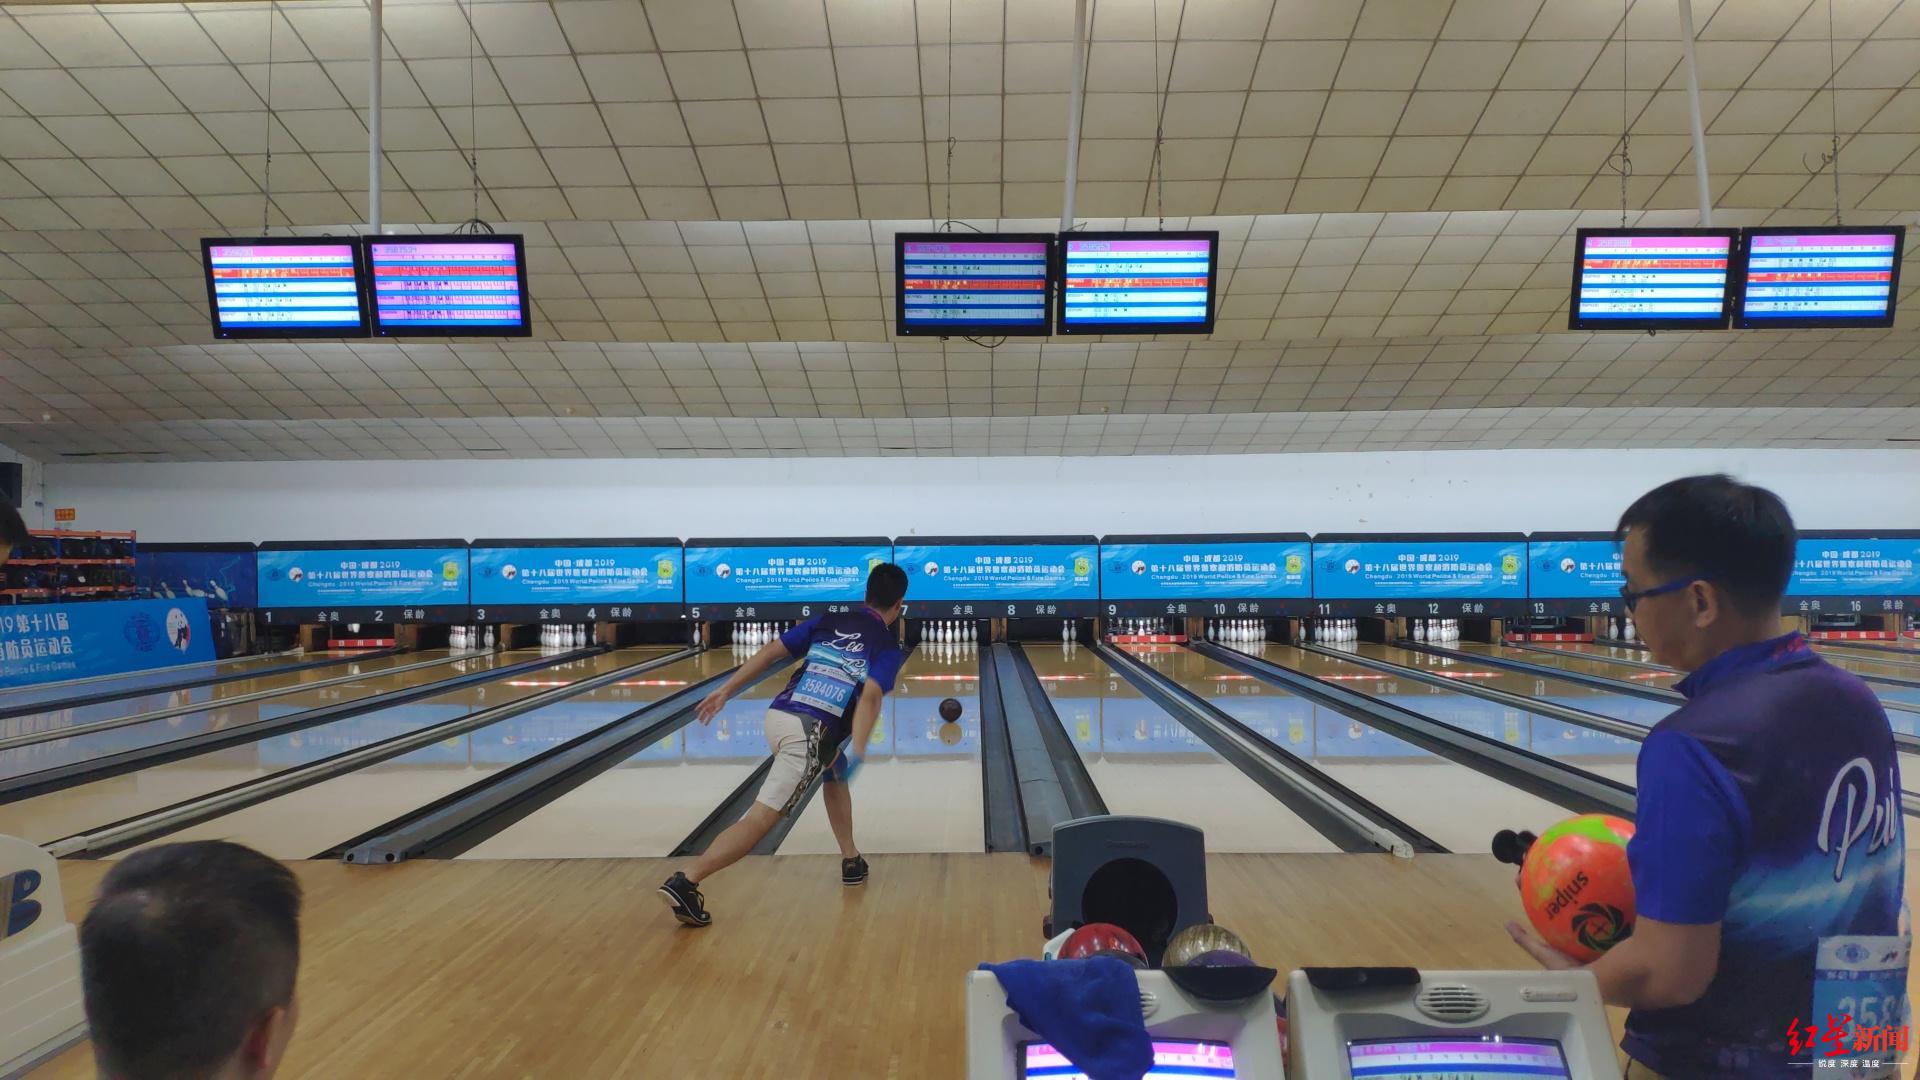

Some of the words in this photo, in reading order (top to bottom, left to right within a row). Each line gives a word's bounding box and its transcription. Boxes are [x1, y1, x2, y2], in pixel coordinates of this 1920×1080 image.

[901, 605, 908, 616] 7
[953, 605, 973, 615] 金奥
[1008, 605, 1015, 615] 8
[1036, 604, 1056, 614] 保龄
[1108, 604, 1116, 615] 9
[1166, 604, 1187, 614] 金奥
[1214, 604, 1225, 614] 10
[1238, 603, 1259, 613] 保龄
[1319, 604, 1330, 614] 11
[1375, 604, 1396, 613] 金奥
[1428, 604, 1438, 614] 12
[1462, 604, 1484, 613] 保龄
[1534, 603, 1544, 613] 13
[1589, 602, 1610, 613] 金奥
[1800, 600, 1820, 610] 金奥
[1851, 601, 1861, 611] 16
[1883, 600, 1904, 609] 保龄
[265, 612, 272, 622] 1
[318, 611, 340, 621] 金奥
[374, 610, 383, 621] 2
[404, 610, 424, 619] 保龄
[477, 610, 485, 620] 3
[540, 609, 560, 619] 金奥
[587, 608, 596, 619] 4
[611, 607, 632, 617] 保龄
[692, 608, 700, 618] 5
[736, 607, 755, 617] 金奥
[802, 606, 810, 616] 6
[16, 613, 69, 633] 第十八届
[801, 678, 846, 702] 3584076
[1546, 872, 1589, 920] sniper
